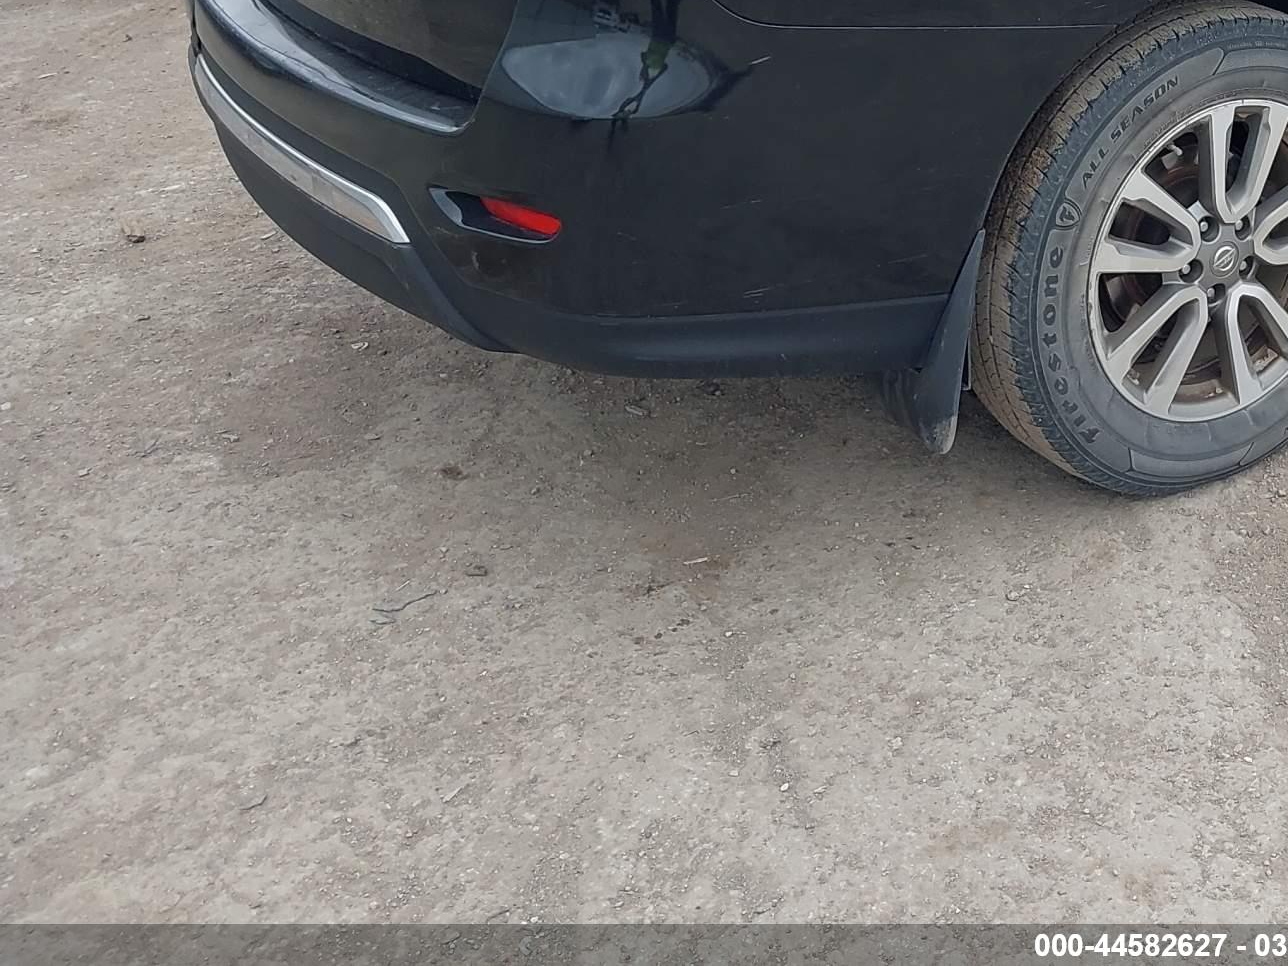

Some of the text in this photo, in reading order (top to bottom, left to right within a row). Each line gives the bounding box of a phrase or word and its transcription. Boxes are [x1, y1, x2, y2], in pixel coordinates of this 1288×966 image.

[1080, 144, 1110, 190] ALL
[1110, 75, 1180, 142] SEASON
[1042, 245, 1100, 444] Firestone
